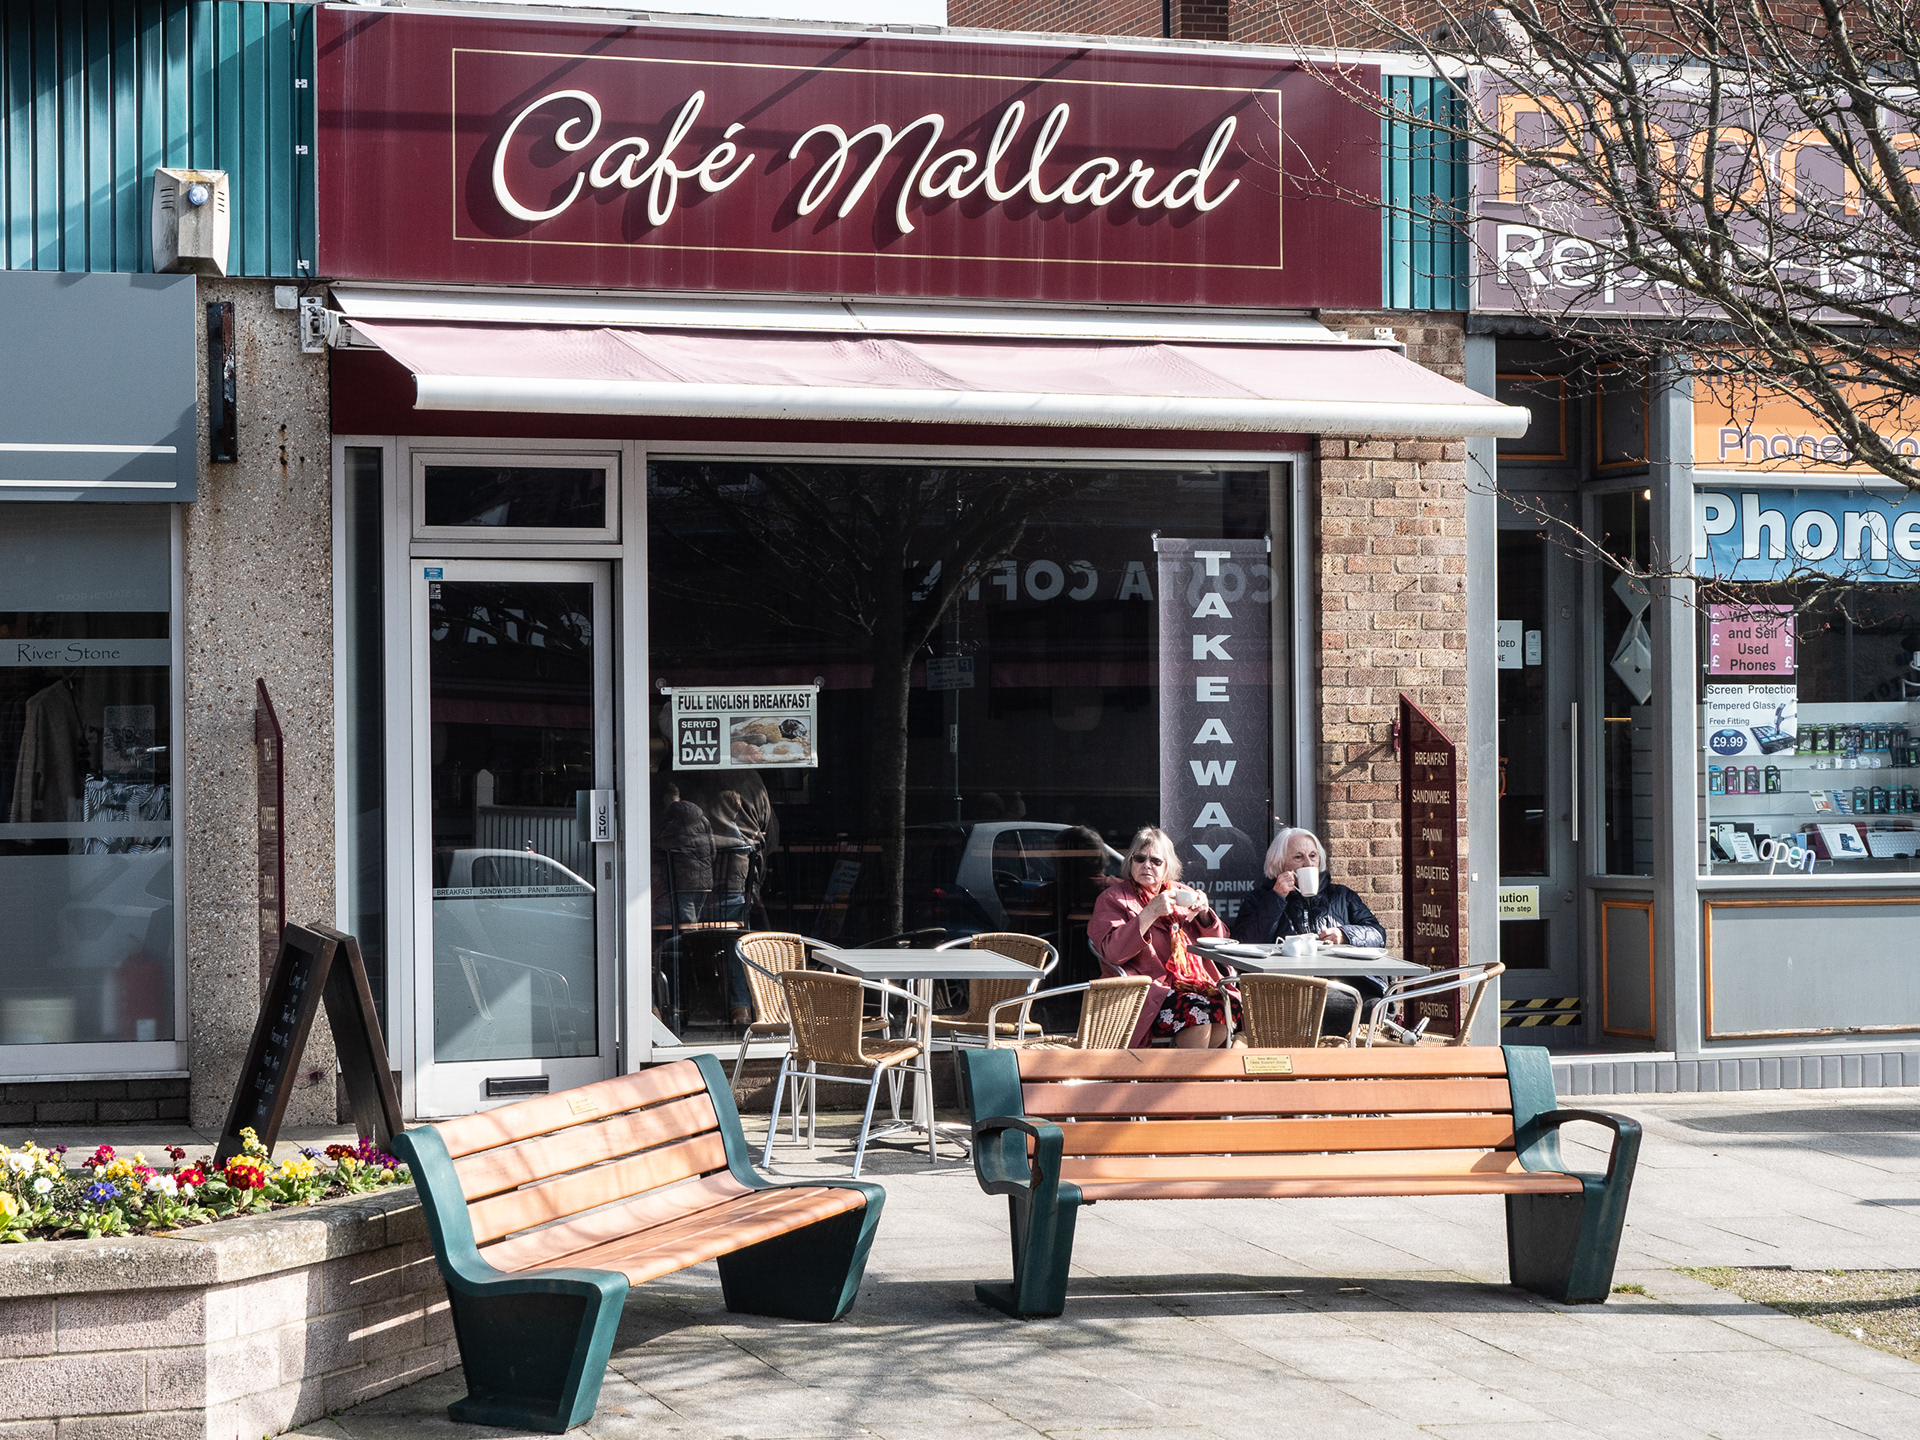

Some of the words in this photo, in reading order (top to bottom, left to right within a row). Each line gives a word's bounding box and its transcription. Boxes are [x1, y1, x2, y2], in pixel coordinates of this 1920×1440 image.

[491, 89, 754, 227] Café
[788, 99, 1240, 235] Mallard
[1497, 224, 1766, 304] Rep
[1695, 492, 1920, 561] Phone
[1729, 627, 1750, 639] and
[1755, 627, 1777, 639] Sell
[17, 643, 61, 663] River
[64, 642, 121, 663] Stone
[1738, 643, 1769, 655] Used
[1730, 659, 1776, 671] Phones
[1707, 685, 1743, 695] Screen
[1748, 684, 1796, 695] Protection
[678, 695, 703, 710] FULL
[706, 694, 750, 710] ENGLISH
[753, 693, 811, 709] BREAKFAST
[1708, 702, 1750, 711] Tempered
[1753, 701, 1776, 710] Glass
[1189, 551, 1237, 869] TAKEAWAY
[681, 720, 718, 729] SERVED
[1727, 717, 1750, 726] Fitting
[682, 730, 718, 745] ALL
[1713, 736, 1743, 747] £9.99
[682, 747, 718, 762] DAY
[1414, 751, 1449, 766] BREAKFAST
[1411, 789, 1450, 804] SANDWICHES
[1758, 838, 1816, 875] open
[1415, 865, 1450, 881] BAGUETTES
[479, 887, 522, 895] SANDWICHES
[1216, 880, 1255, 892] DRINK
[1499, 893, 1529, 903] aution
[1422, 903, 1442, 918] DAILY
[1517, 906, 1531, 914] step
[1416, 922, 1450, 939] SPECIALS
[1420, 1001, 1449, 1019] PASTRIES
